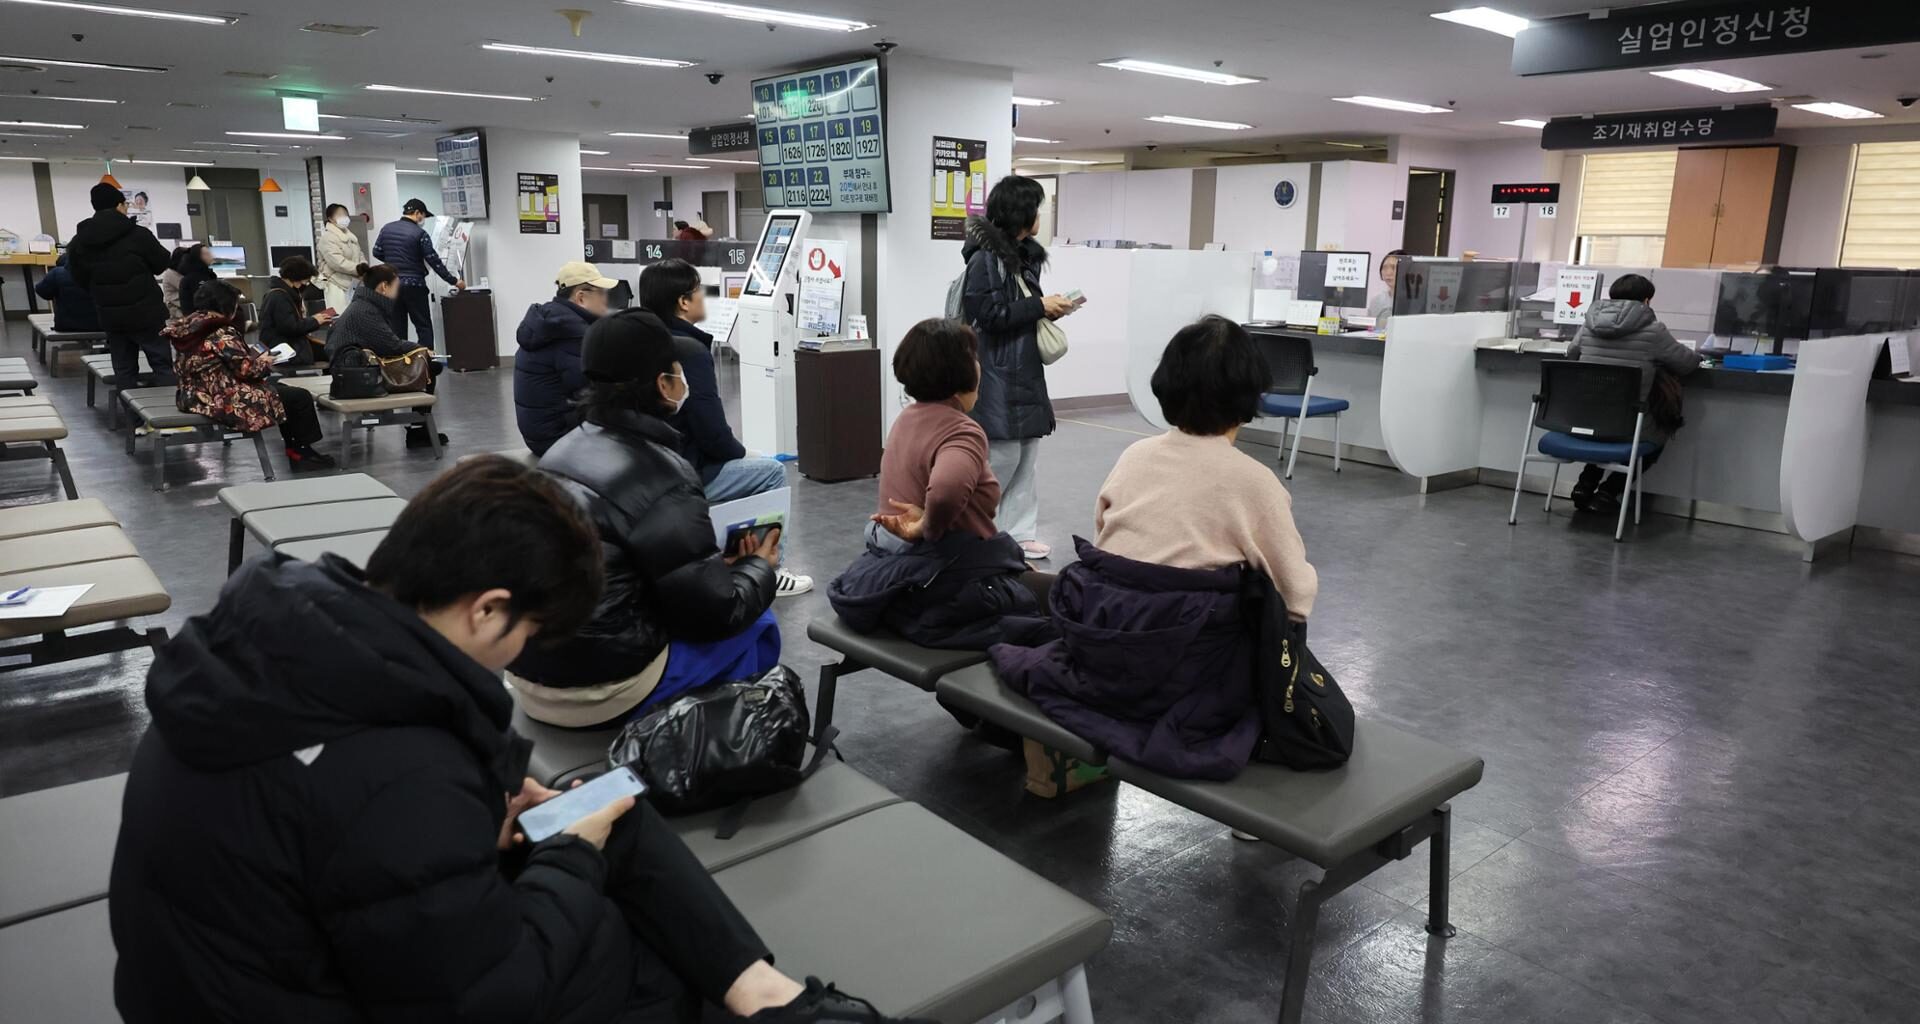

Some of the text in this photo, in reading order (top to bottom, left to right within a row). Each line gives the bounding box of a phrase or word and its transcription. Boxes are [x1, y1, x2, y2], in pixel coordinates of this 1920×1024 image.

[1616, 6, 1811, 55] 실업인정신청
[760, 88, 769, 98] 10
[782, 84, 791, 96] 11
[806, 80, 816, 92] 12
[831, 76, 841, 89] 13
[765, 120, 872, 143] 15 16 17 18 19
[1592, 117, 1714, 140] 조기재취업수당
[710, 131, 750, 148] 실업인정신청
[784, 139, 878, 160] 1626 1726 1820 1927
[768, 170, 823, 185] 20 21 22
[788, 188, 830, 202] 2116 2224
[1497, 207, 1507, 215] 17
[1542, 206, 1554, 215] 18
[646, 245, 662, 259] 14
[729, 249, 745, 264] 15
